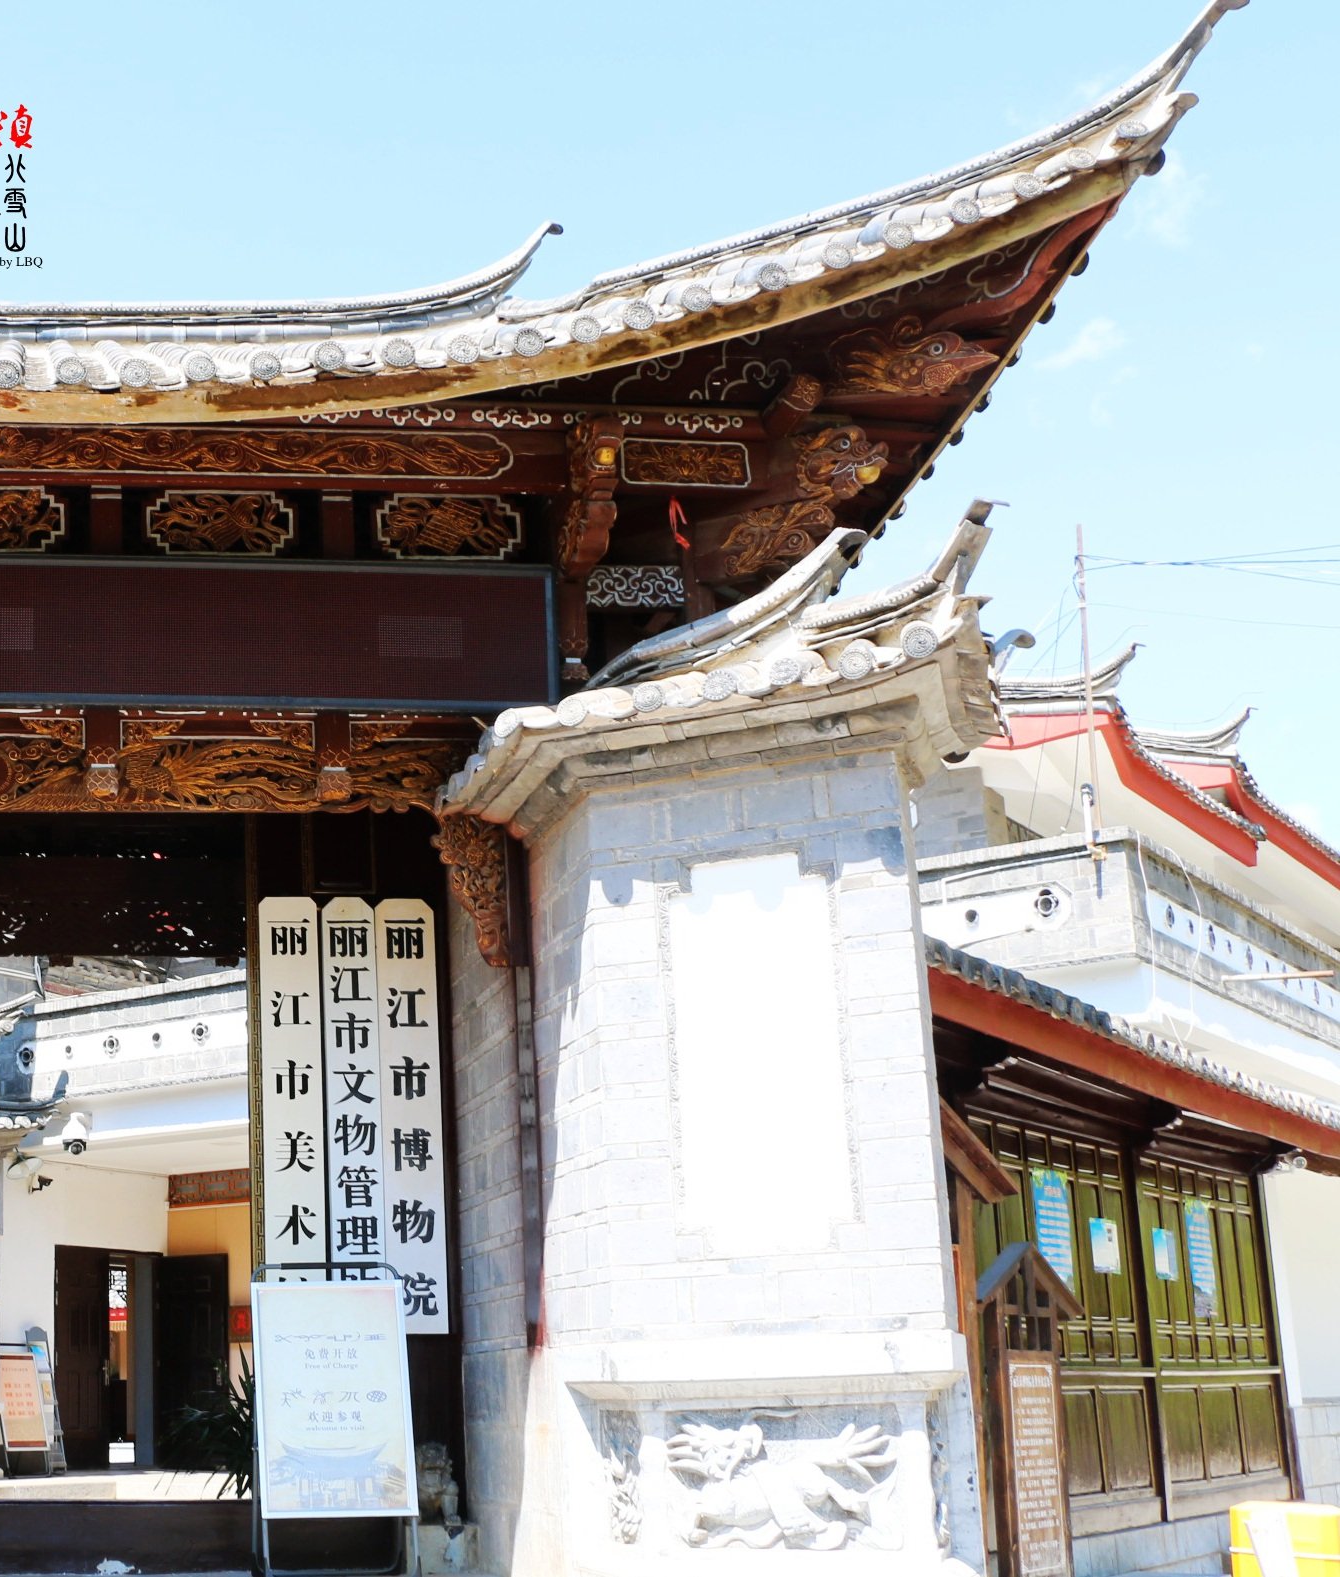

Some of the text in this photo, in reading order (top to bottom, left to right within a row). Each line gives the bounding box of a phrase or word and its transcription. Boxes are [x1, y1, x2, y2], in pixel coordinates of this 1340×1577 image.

[267, 918, 317, 1281] 丽江市美术
[384, 918, 439, 1316] 丽江市博物院
[305, 1347, 358, 1360] 免费开放
[305, 1362, 359, 1371] Free of Charge
[308, 1411, 363, 1423] 欢迎参观
